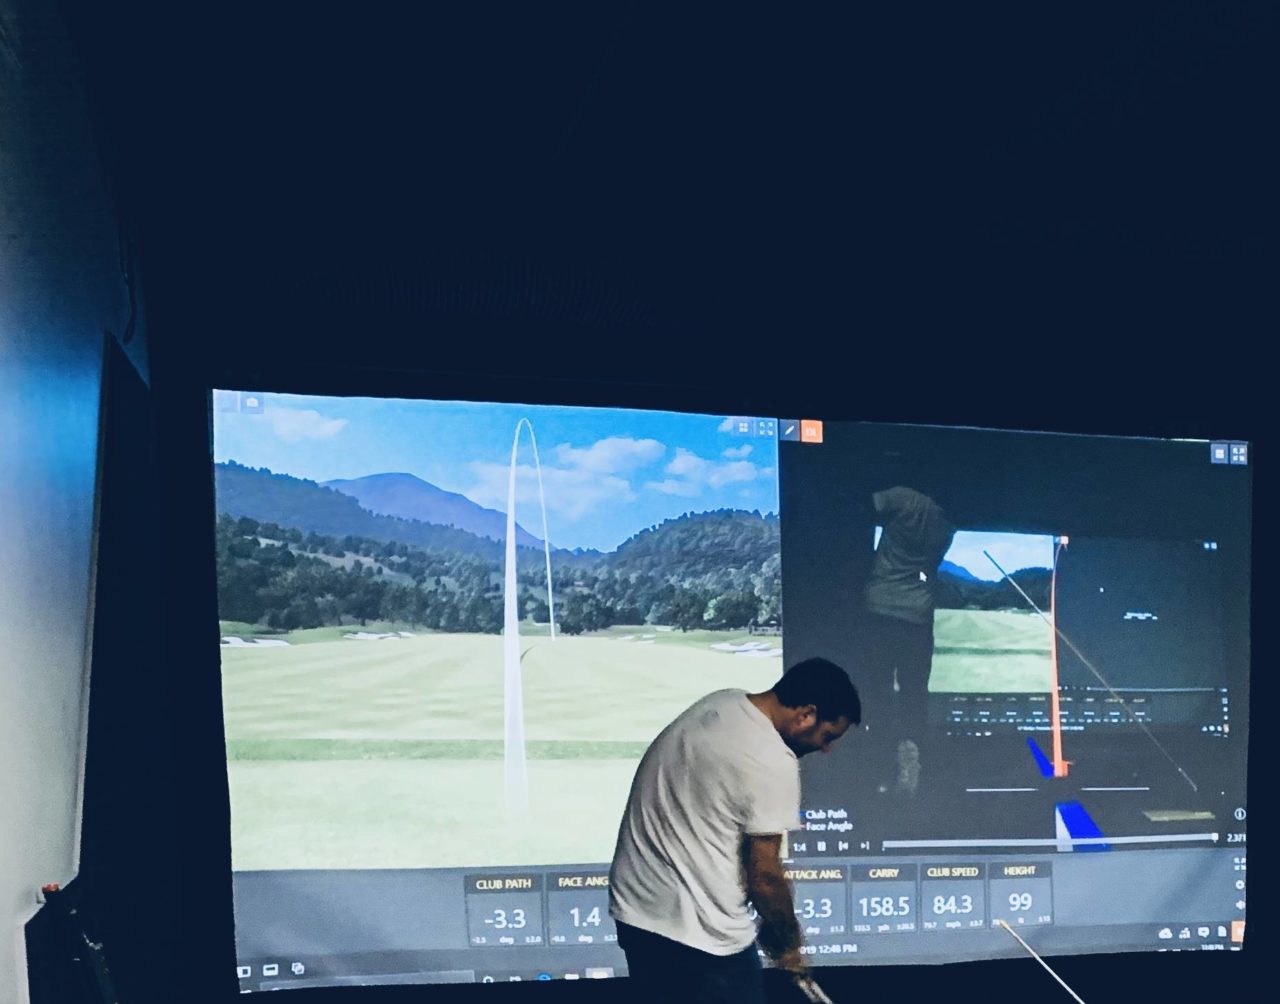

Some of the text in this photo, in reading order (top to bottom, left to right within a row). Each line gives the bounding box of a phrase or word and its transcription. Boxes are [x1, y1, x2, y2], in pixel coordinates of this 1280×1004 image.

[806, 808, 847, 819] Club Path
[806, 821, 853, 832] Face Angle
[784, 870, 818, 880] ATTACK
[869, 868, 899, 878] CARRY
[927, 867, 979, 877] CLUB SPEED
[1004, 865, 1036, 876] HEIGHT
[475, 878, 532, 890] CLUB PATH
[558, 877, 584, 887] FACE
[859, 896, 910, 917] 158.5
[933, 895, 973, 914] 84.3
[1009, 893, 1032, 911] 99
[794, 898, 832, 919] -3.3
[484, 909, 527, 929] -3.3
[570, 906, 601, 928] 1.4
[843, 944, 858, 953] PM
